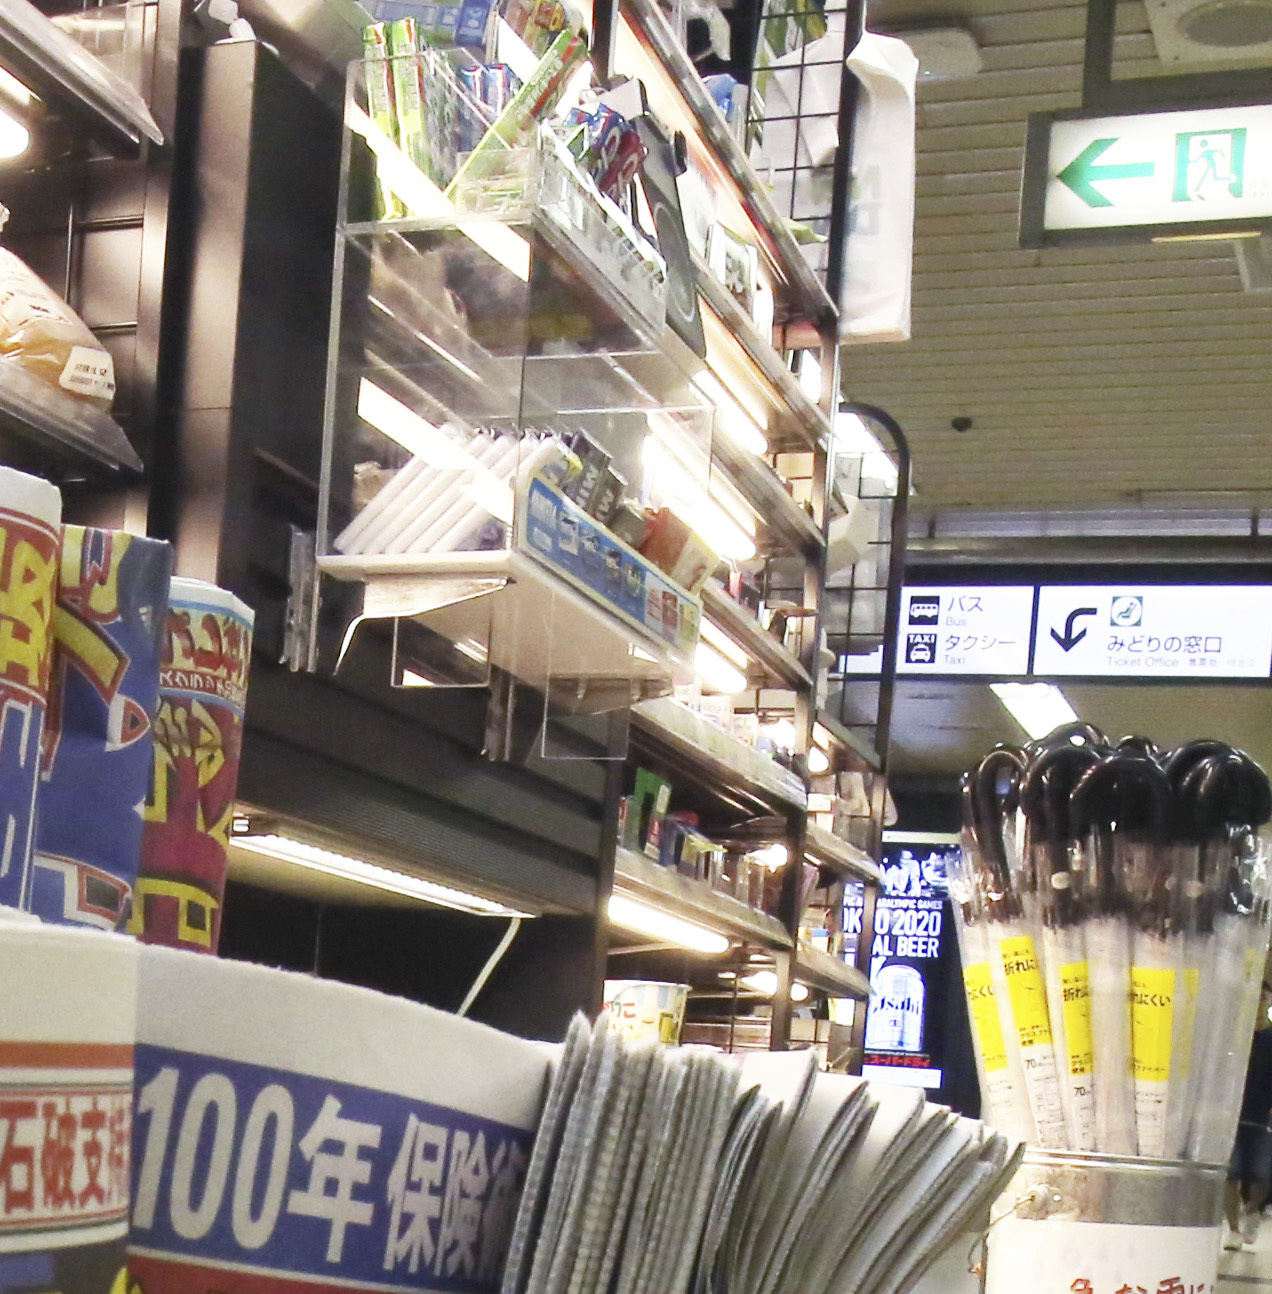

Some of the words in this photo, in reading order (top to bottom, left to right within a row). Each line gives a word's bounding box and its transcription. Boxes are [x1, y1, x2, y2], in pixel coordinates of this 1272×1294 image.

[947, 596, 984, 613] バス
[945, 616, 968, 627] Bus
[944, 635, 1016, 652] タクシー
[1106, 636, 1223, 654] みどりの窓口
[943, 654, 966, 666] Taxi
[1106, 656, 1142, 668] Ticket
[1144, 656, 1180, 668] Office
[893, 910, 942, 936] 2020
[896, 936, 940, 958] BEER
[873, 994, 920, 1016] Asahi
